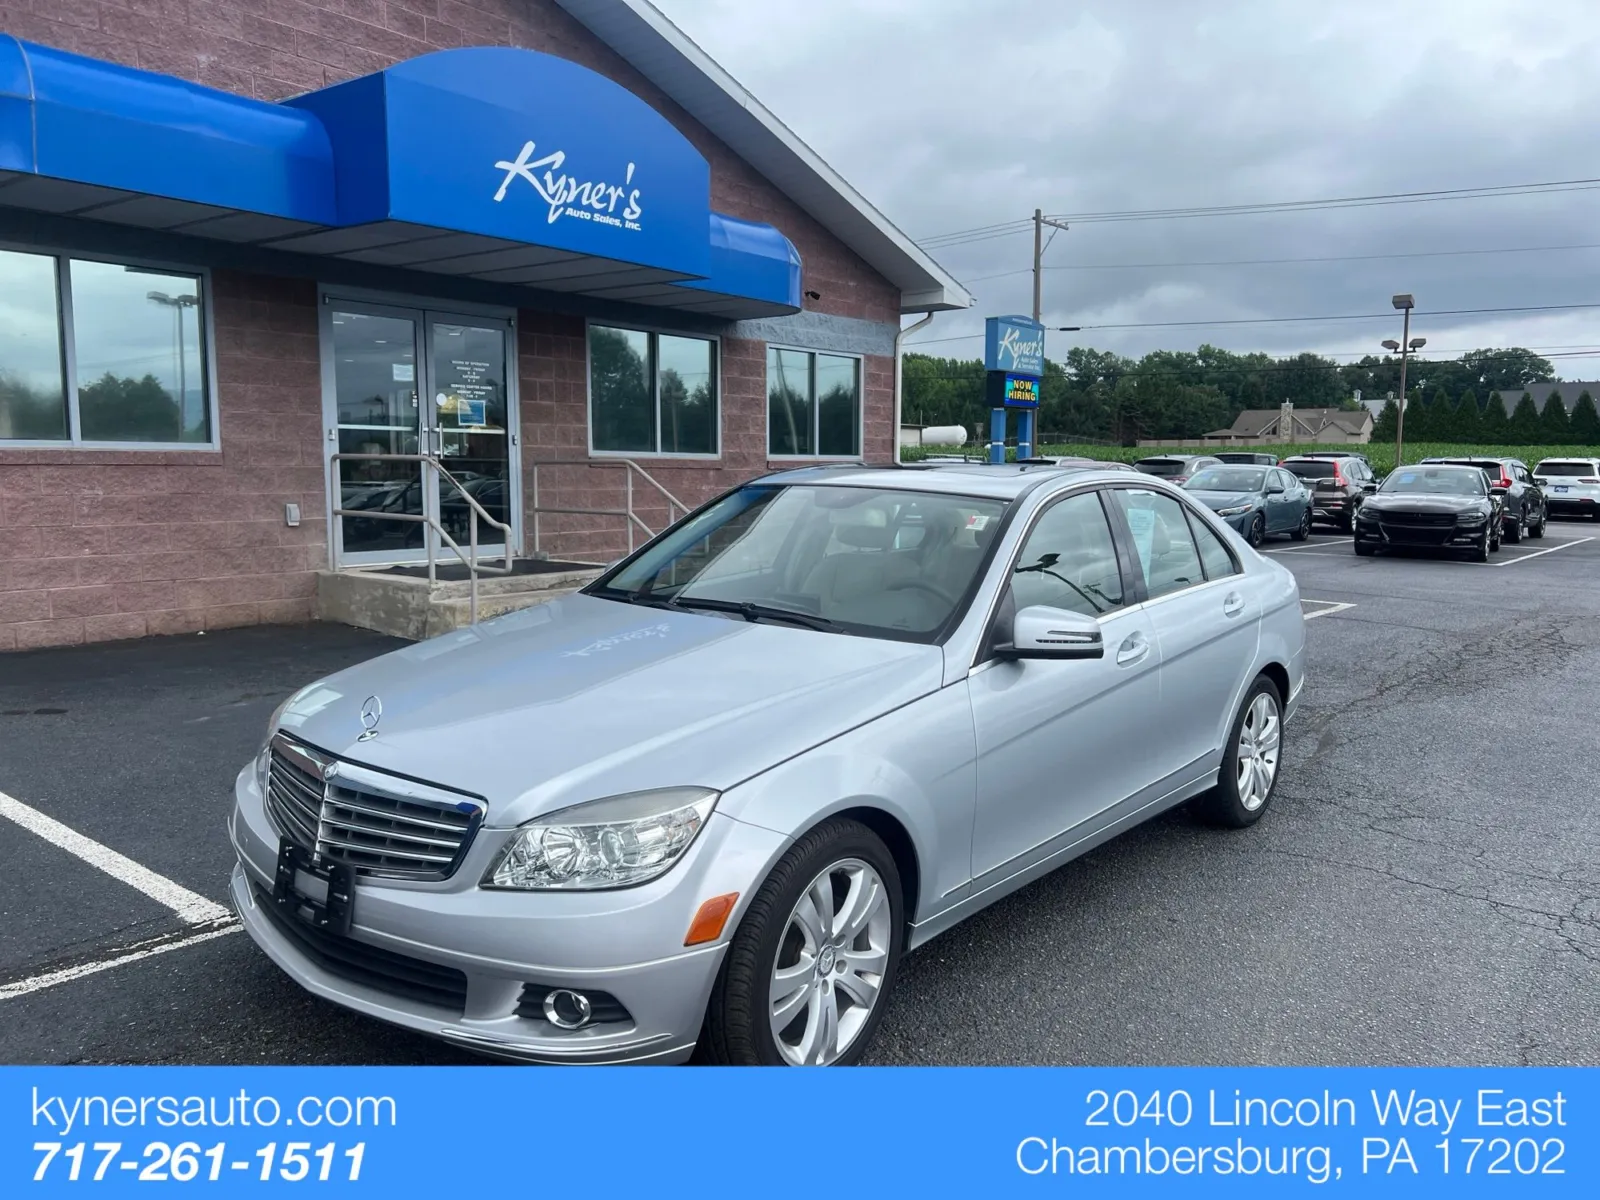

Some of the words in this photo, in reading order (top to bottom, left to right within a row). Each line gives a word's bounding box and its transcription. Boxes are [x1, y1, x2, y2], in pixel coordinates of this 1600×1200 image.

[494, 140, 642, 224] Kyner's
[565, 207, 592, 220] Auto
[593, 213, 622, 228] Sales,
[998, 327, 1042, 370] Kyner's
[1014, 379, 1033, 390] NOW
[1008, 390, 1036, 401] HIRING
